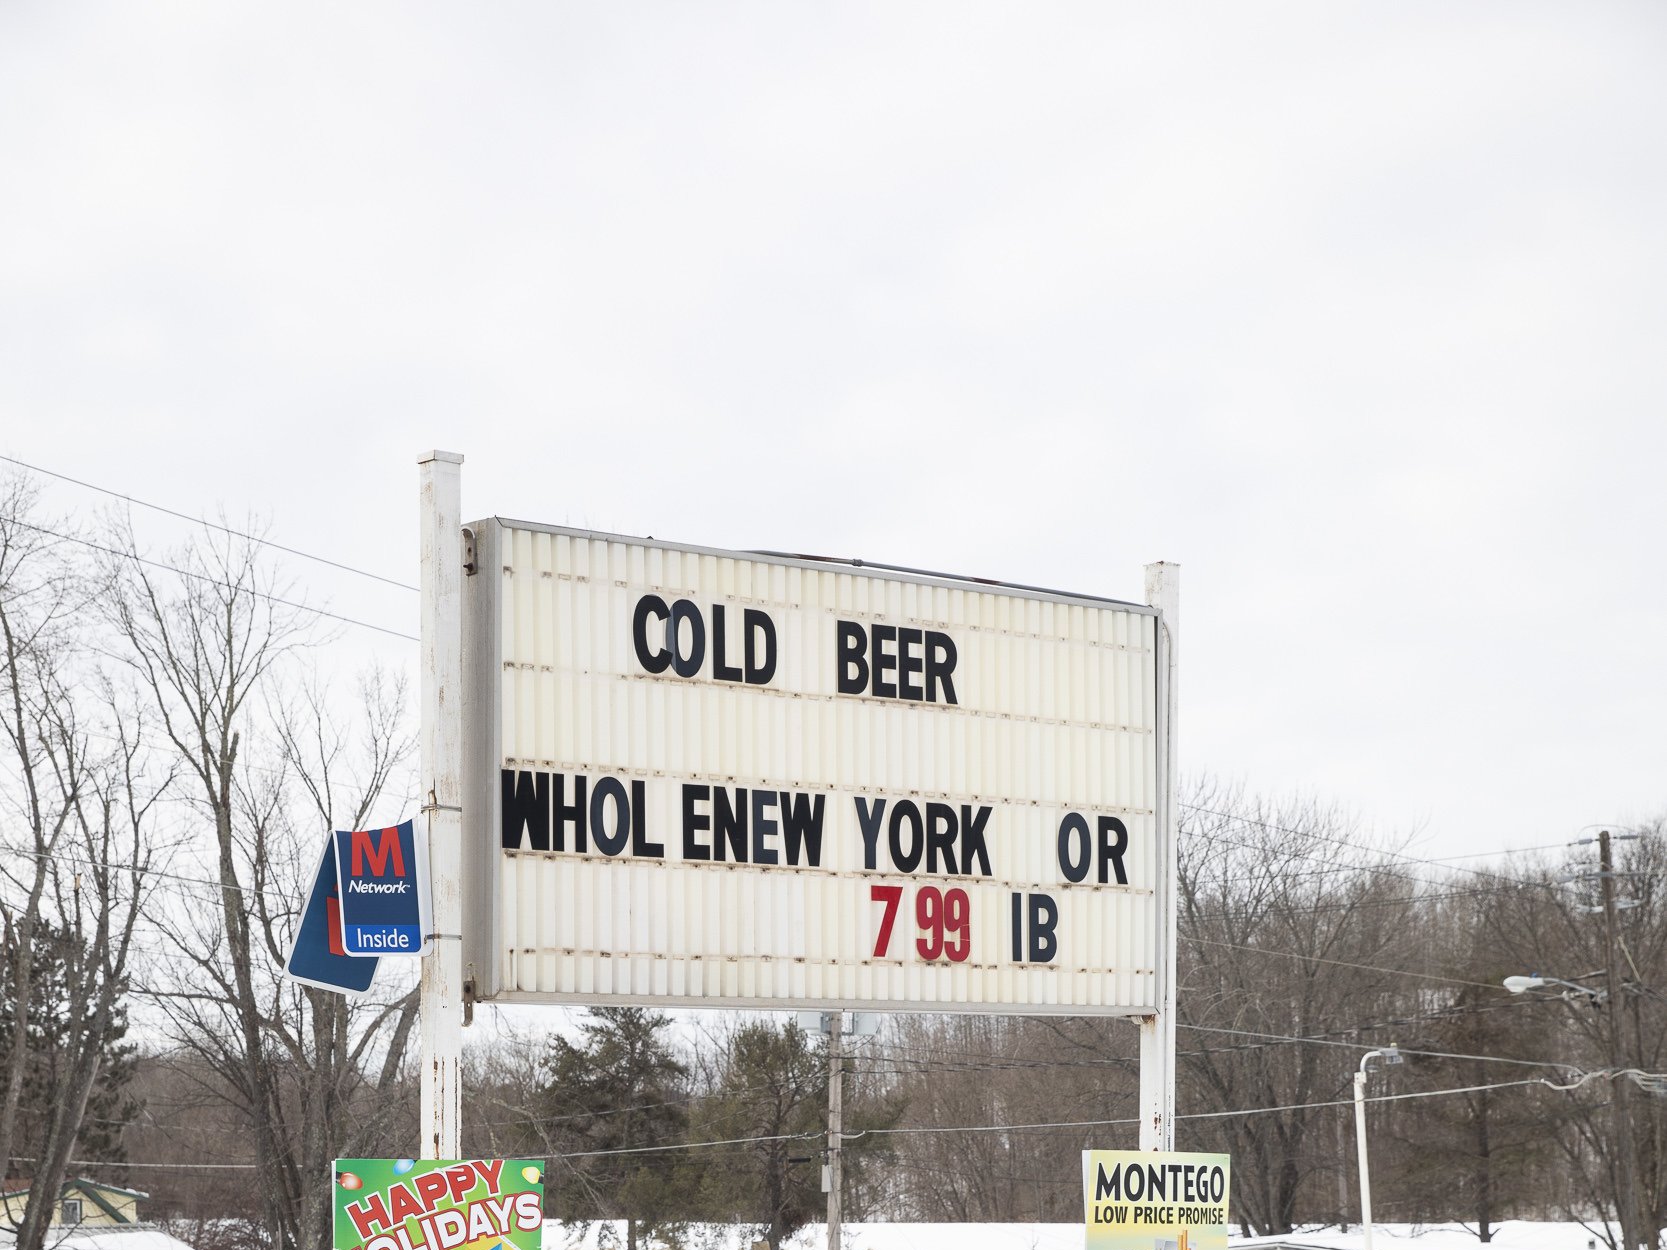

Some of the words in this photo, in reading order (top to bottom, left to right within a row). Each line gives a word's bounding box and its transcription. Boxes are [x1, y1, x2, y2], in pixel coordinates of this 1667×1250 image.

[633, 594, 777, 684] COLD
[838, 620, 958, 705] BEER
[351, 827, 406, 877] M
[853, 797, 992, 878] YORK
[1058, 812, 1128, 888] OR
[357, 928, 409, 948] Inside
[344, 1159, 504, 1242] HAPPY
[1095, 1162, 1225, 1203] MONTEGO
[1094, 1205, 1129, 1224] LOW
[1133, 1206, 1174, 1225] PRICE
[1178, 1207, 1224, 1225] PROMISE
